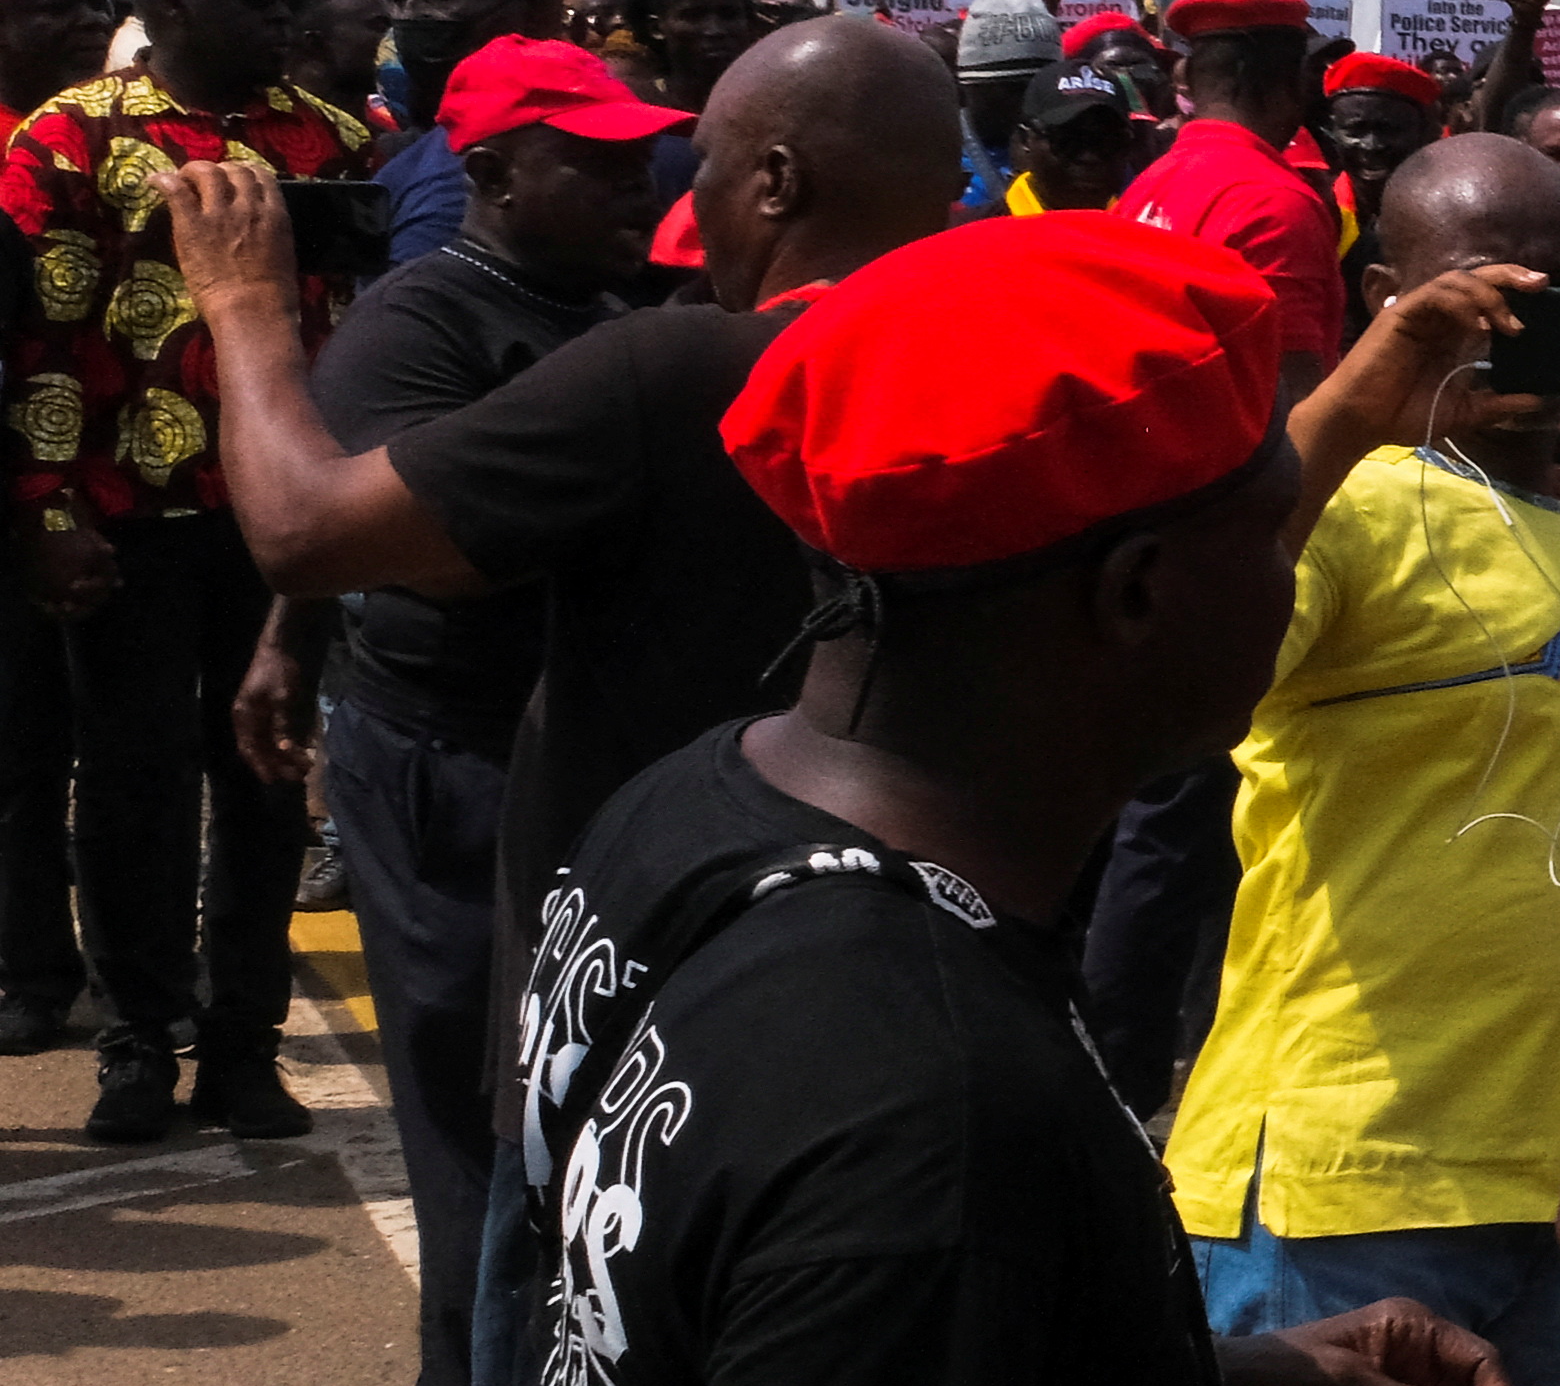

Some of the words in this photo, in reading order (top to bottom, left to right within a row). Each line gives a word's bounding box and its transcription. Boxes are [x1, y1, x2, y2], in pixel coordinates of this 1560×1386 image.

[1461, 1, 1484, 16] the
[1391, 13, 1446, 32] Police
[1398, 33, 1459, 52] They
